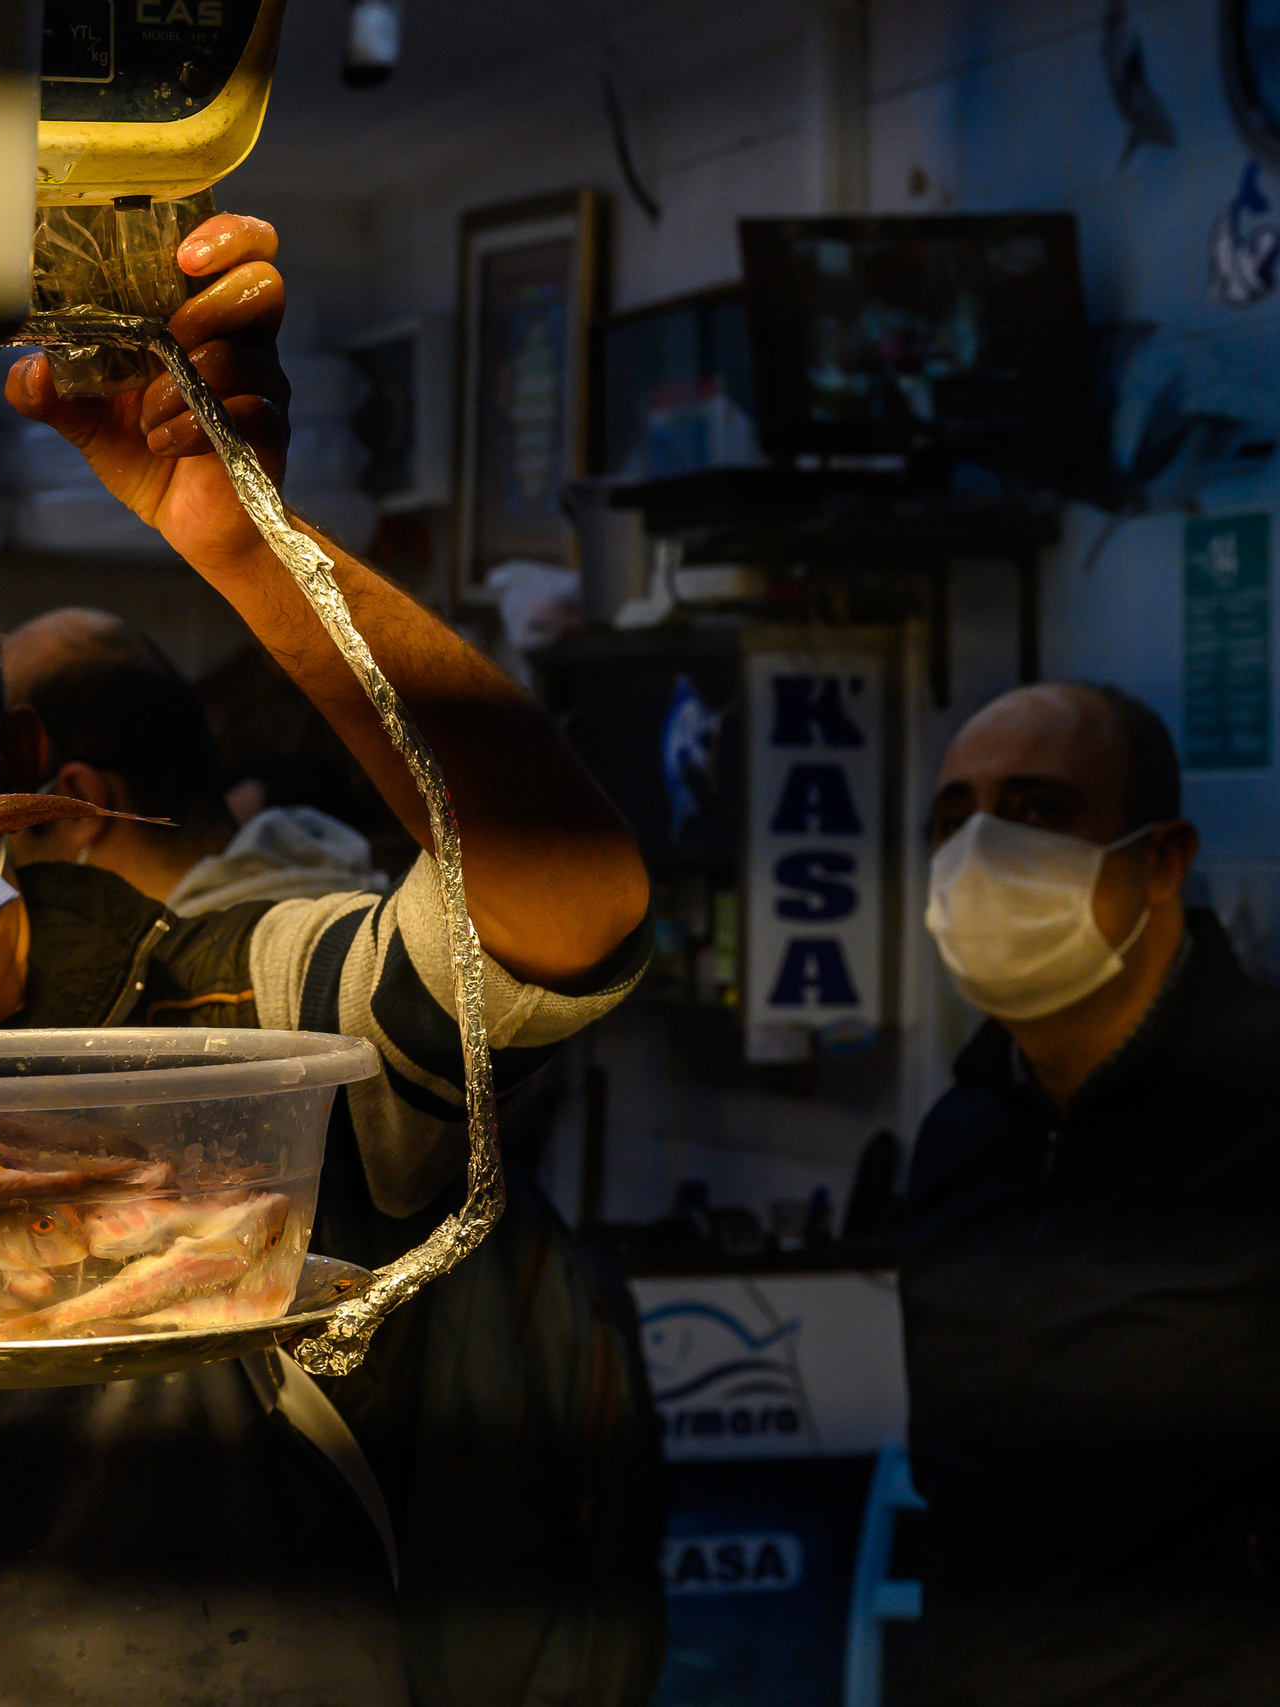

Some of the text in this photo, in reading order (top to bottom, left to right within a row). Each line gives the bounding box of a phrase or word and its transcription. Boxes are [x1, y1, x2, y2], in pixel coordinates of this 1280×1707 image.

[136, 0, 223, 27] CAS
[142, 30, 182, 42] MODEL
[91, 48, 109, 66] kg
[656, 1407, 799, 1437] rmara
[660, 1543, 787, 1583] ASA
